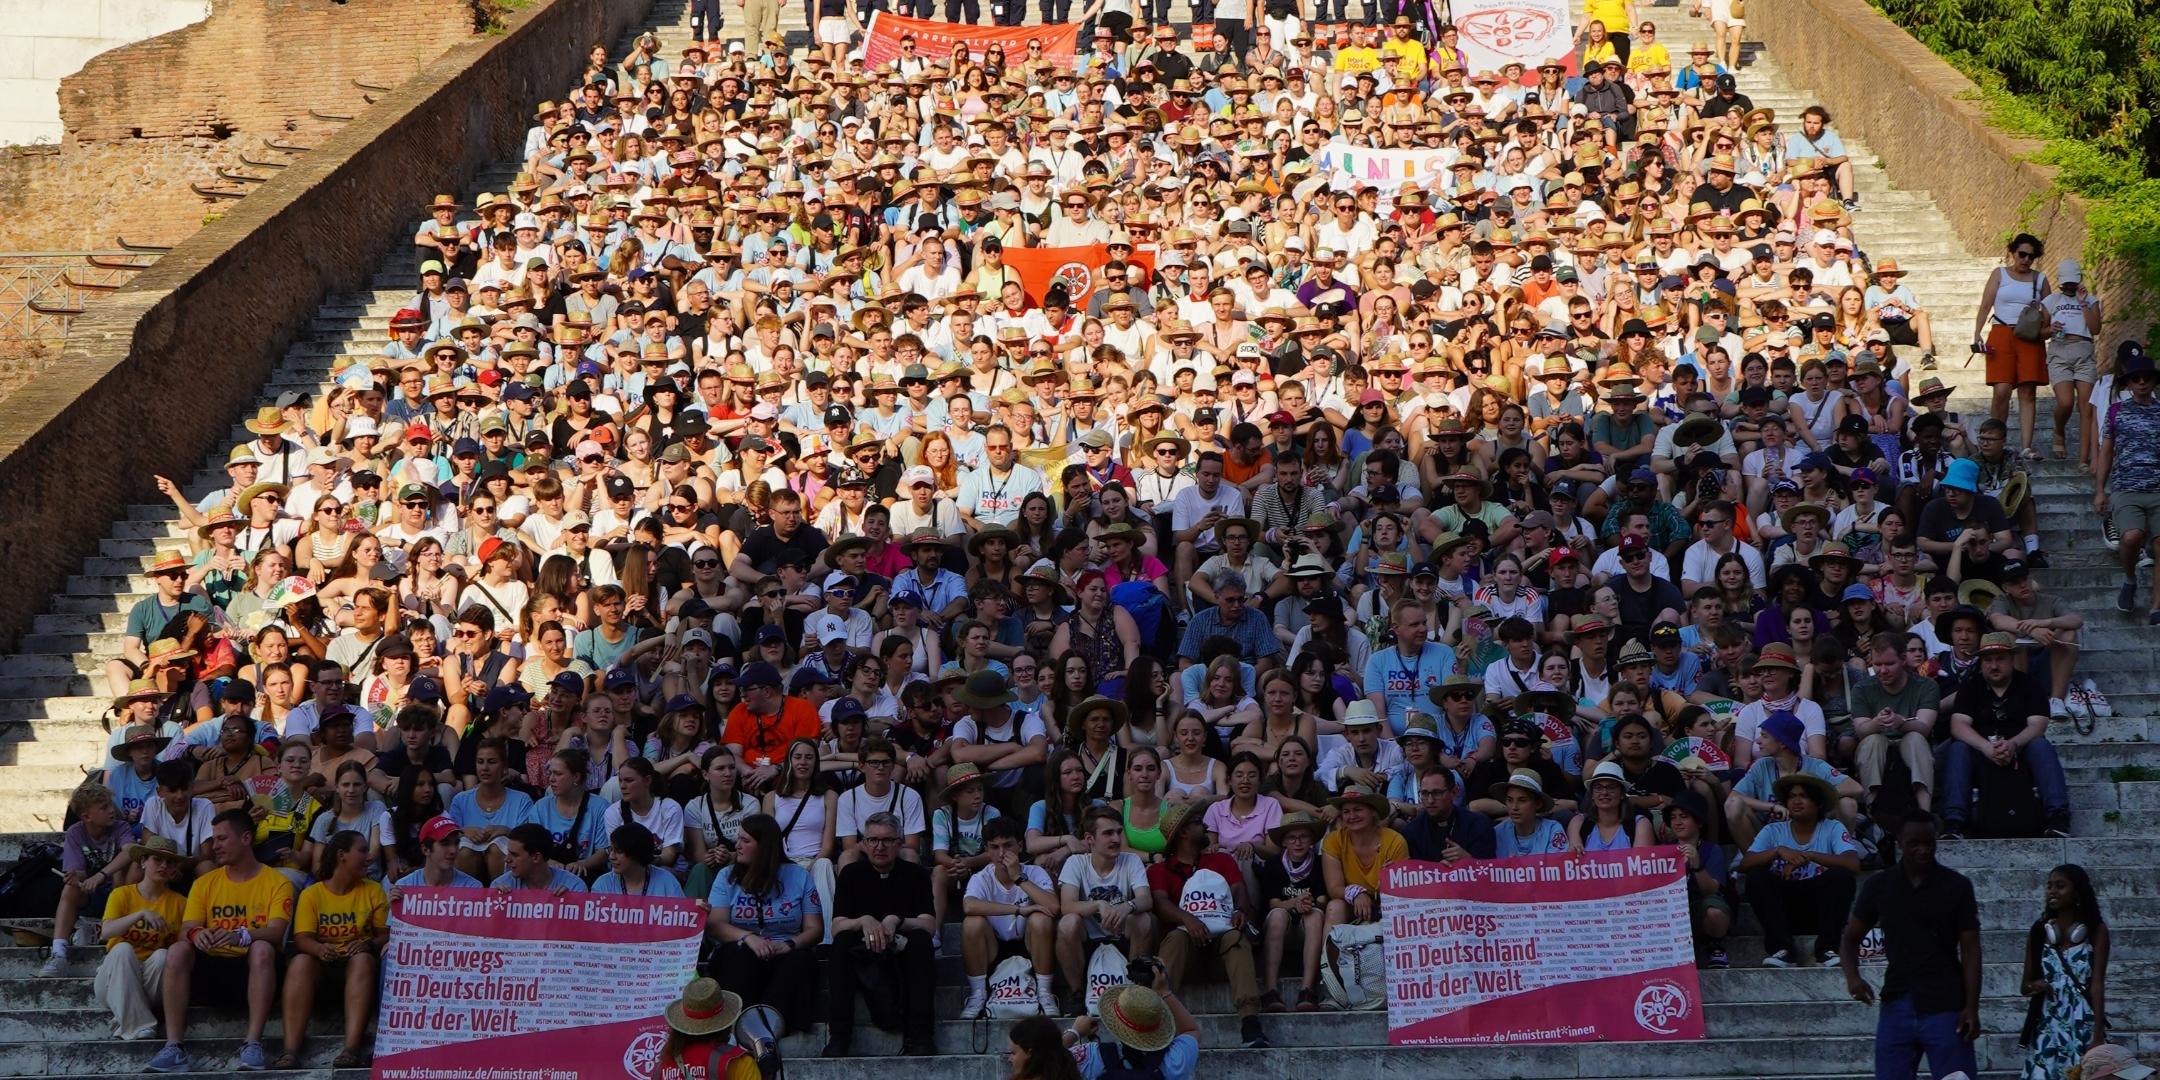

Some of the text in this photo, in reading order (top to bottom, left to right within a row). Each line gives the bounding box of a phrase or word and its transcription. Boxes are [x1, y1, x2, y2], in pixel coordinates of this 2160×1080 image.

[893, 26, 954, 44] PFARREI
[982, 490, 1008, 500] ROM
[981, 500, 1009, 510] 2024
[1388, 670, 1420, 680] ROM
[1388, 680, 1421, 690] 2024
[1710, 703, 1731, 711] ROM
[1668, 742, 1720, 762] ROM 2024
[1540, 862, 1560, 882] im
[1564, 858, 1624, 881] Bistum
[1628, 852, 1677, 876] Mainz
[211, 906, 246, 918] ROM
[320, 912, 356, 926] ROM
[558, 901, 578, 921] im
[584, 901, 644, 925] Bistum
[648, 905, 698, 928] Mainz
[320, 925, 358, 938] 2024
[1393, 913, 1498, 938] Unterwegs
[1861, 938, 1886, 949] OM
[396, 942, 504, 974] Unterwegs
[1396, 938, 1536, 970] in Deutschland
[393, 972, 538, 1002] in Deutschland
[1091, 972, 1123, 987] ROM
[1398, 968, 1524, 1001] und der Welt
[389, 1006, 518, 1032] und der Welt
